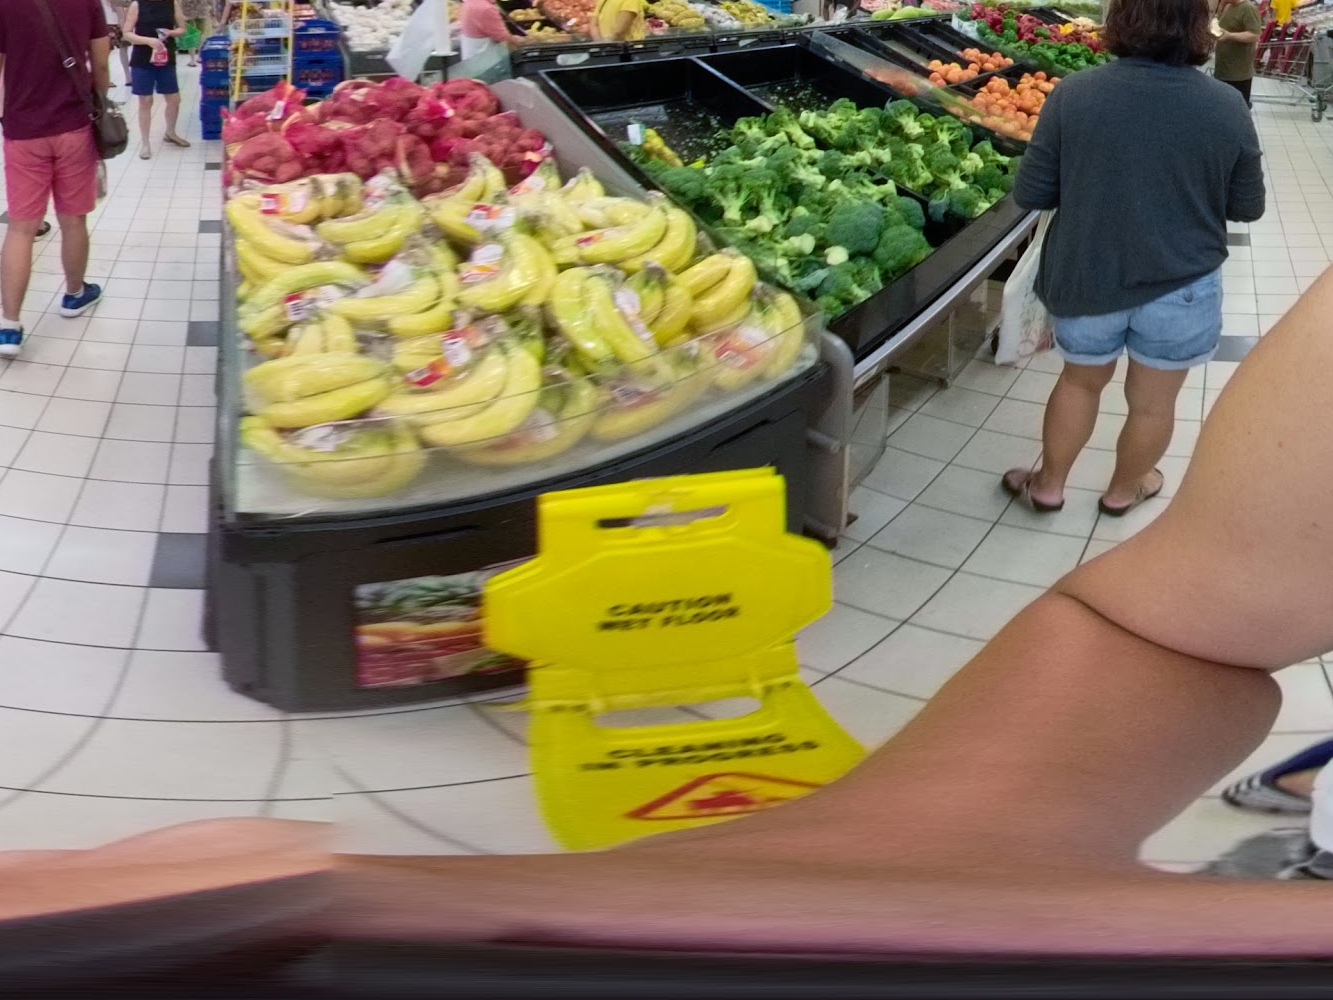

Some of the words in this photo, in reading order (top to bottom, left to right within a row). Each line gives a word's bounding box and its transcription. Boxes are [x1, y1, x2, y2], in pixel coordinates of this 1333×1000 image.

[606, 593, 732, 617] CAUTION
[596, 618, 652, 633] WET
[661, 605, 742, 629] FLOOR
[577, 761, 621, 771] IN
[635, 740, 821, 769] PROGRESS
[605, 733, 787, 759] CLEANING
